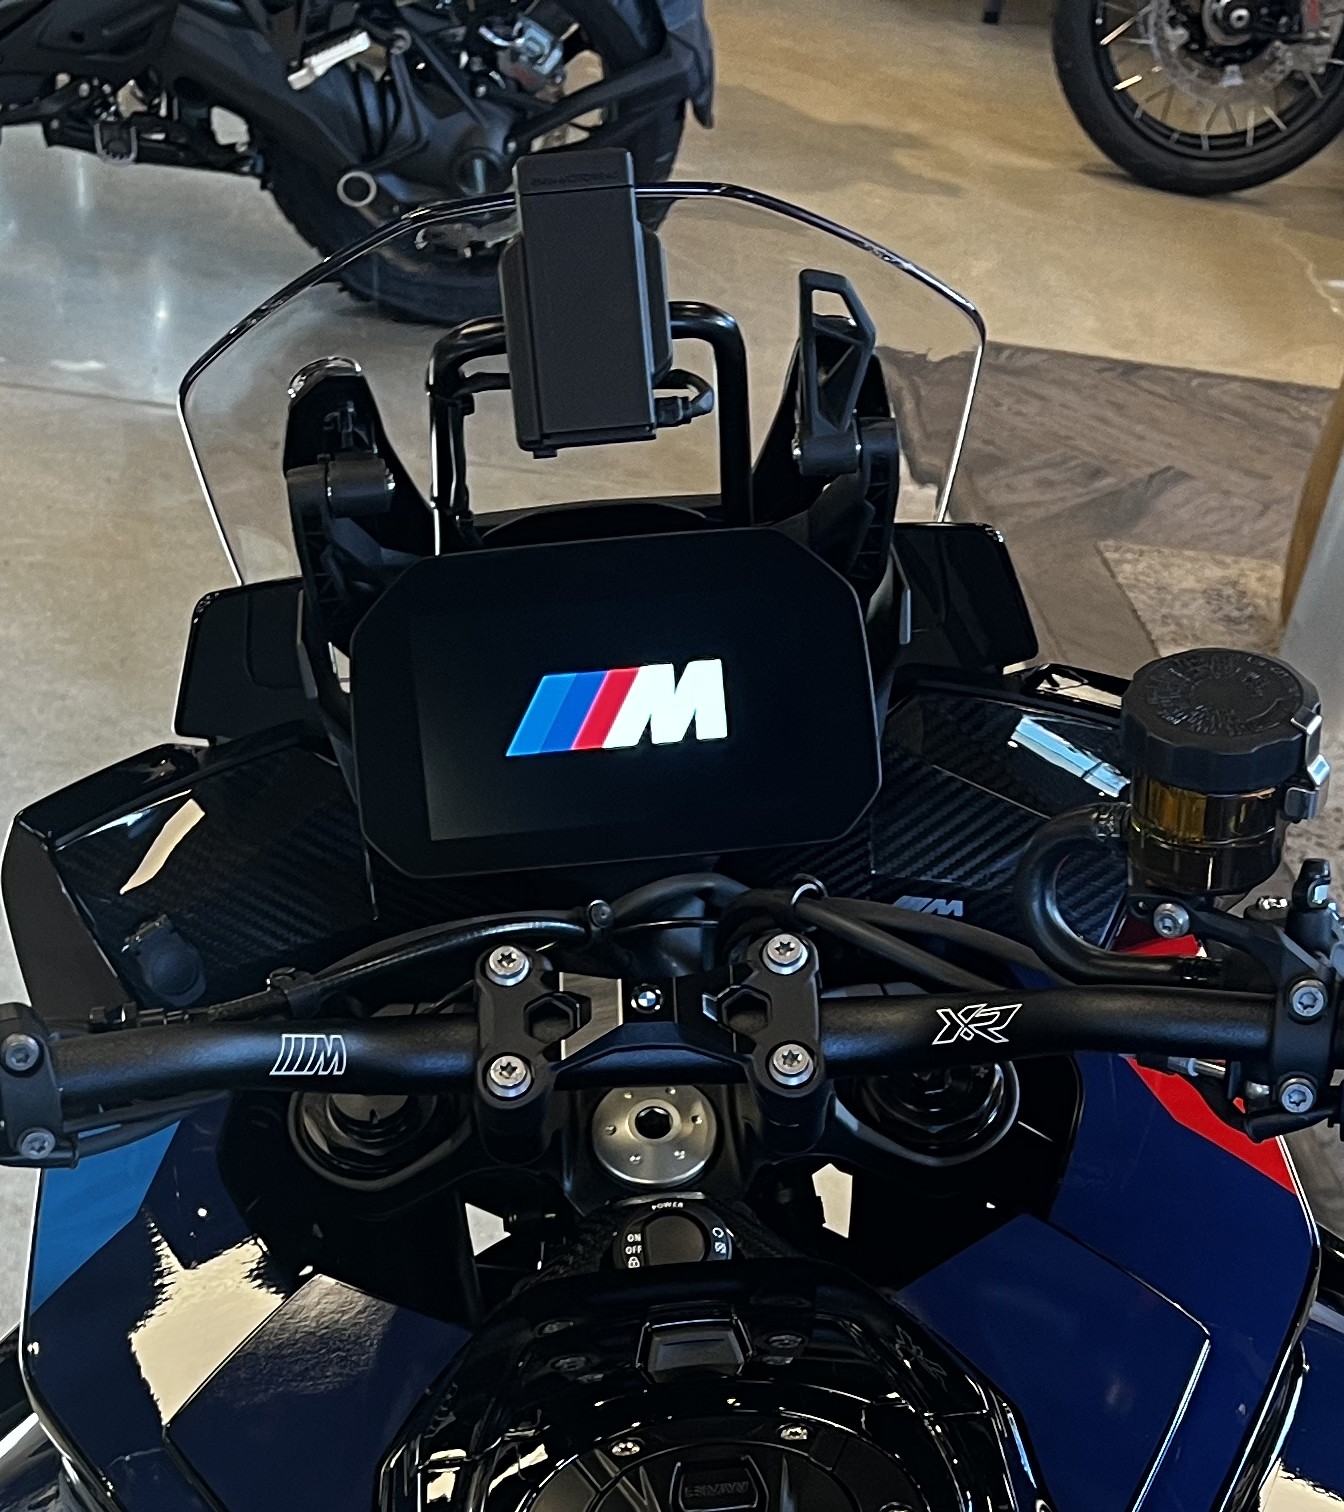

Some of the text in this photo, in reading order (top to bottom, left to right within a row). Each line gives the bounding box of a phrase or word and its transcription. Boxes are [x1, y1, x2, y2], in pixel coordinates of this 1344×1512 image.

[931, 1003, 1023, 1045] XR
[651, 1201, 684, 1210] POWER
[626, 1233, 642, 1243] ON
[625, 1245, 642, 1255] OFF
